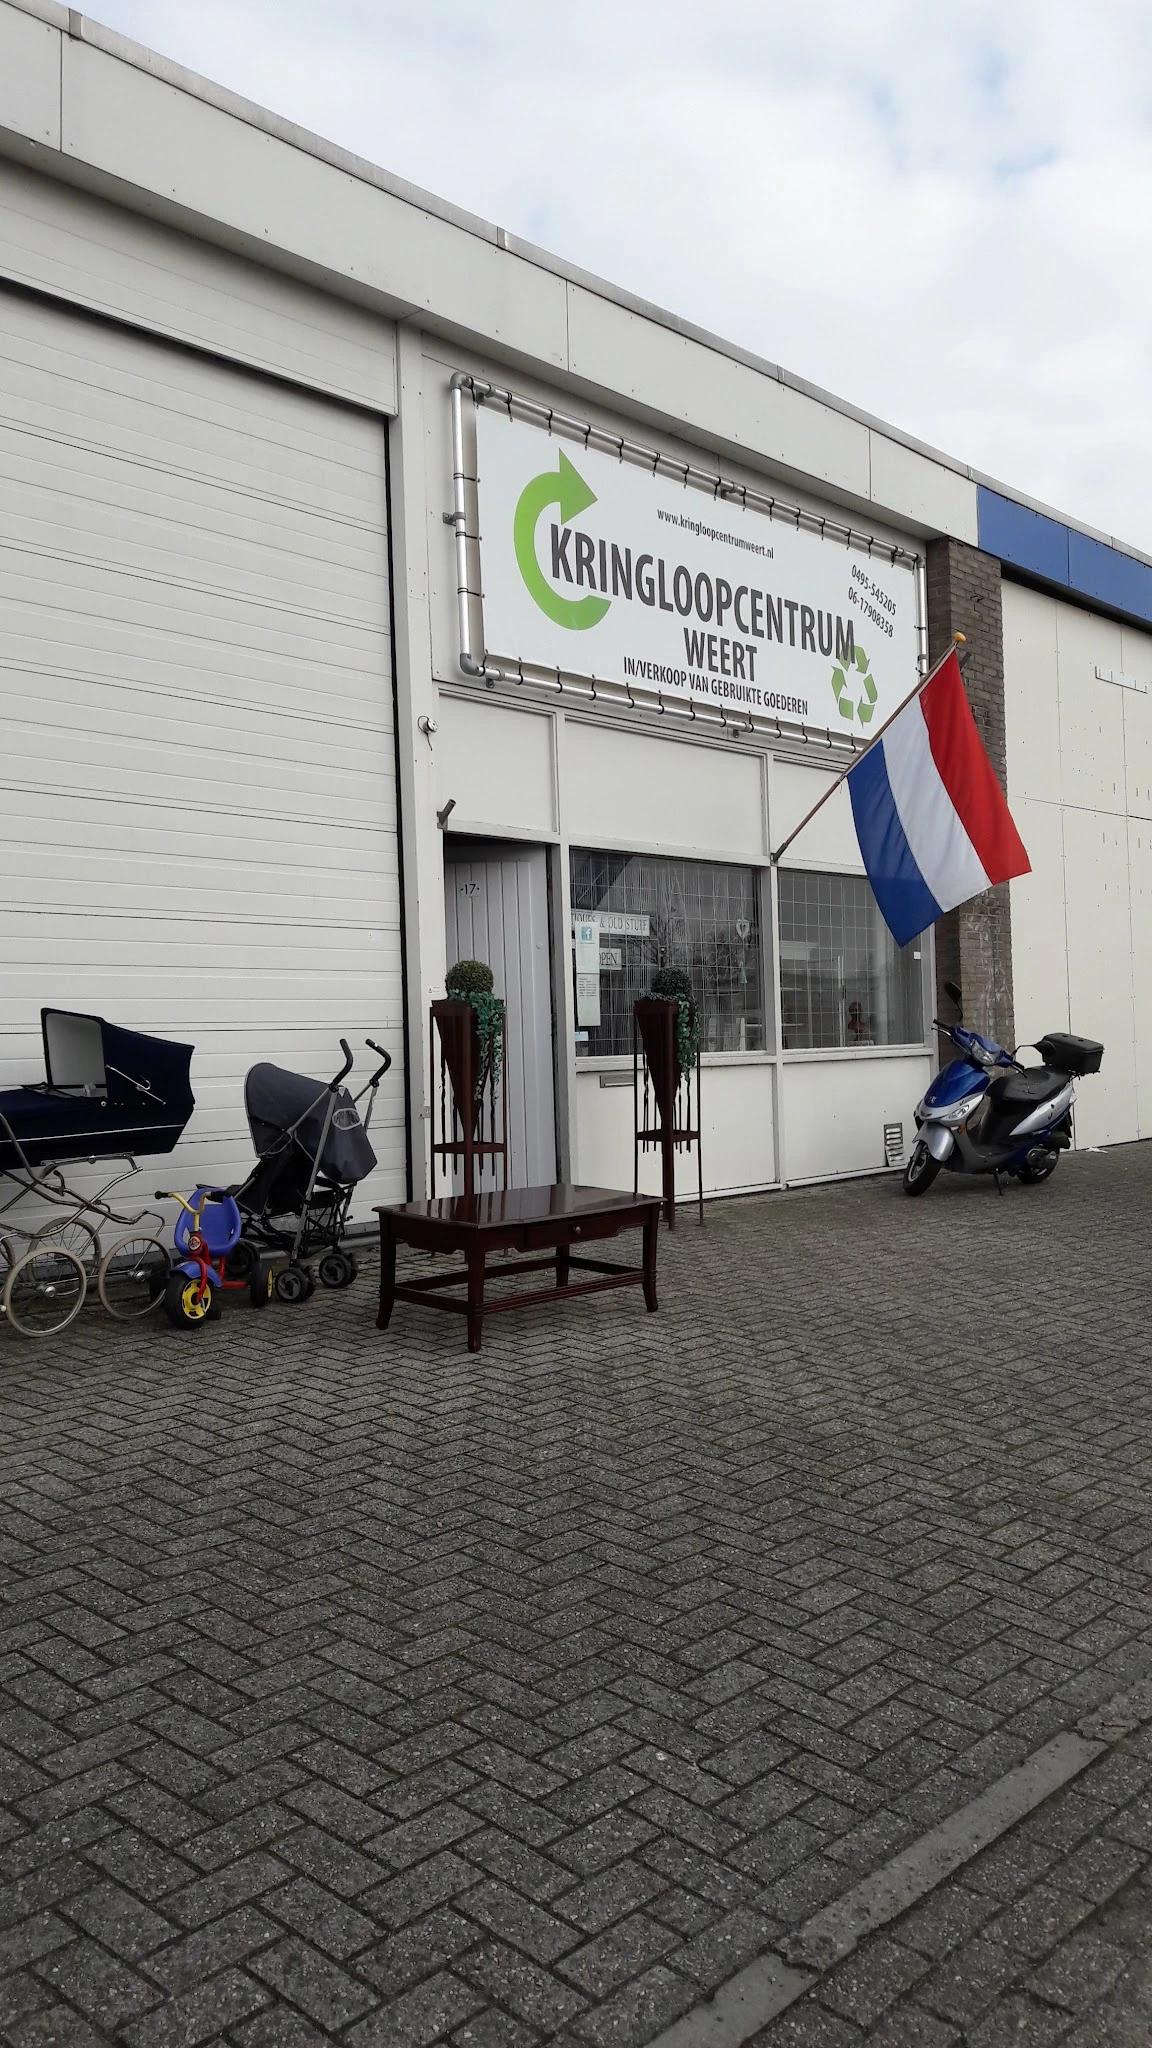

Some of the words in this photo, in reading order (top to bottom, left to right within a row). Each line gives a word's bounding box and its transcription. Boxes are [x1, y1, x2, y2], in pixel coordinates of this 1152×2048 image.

[657, 508, 774, 559] www.kringloopcentrumweert.nl
[550, 523, 856, 664] KRINGLOOPCENTRUM
[848, 586, 894, 638] 06-17908358
[851, 564, 897, 616] 0495-545205
[683, 627, 757, 682] WEERT
[623, 656, 687, 688] IN/VERKOOP
[688, 672, 709, 693] VAN
[711, 678, 762, 706] GEBRUIKTE
[763, 691, 808, 716] GOEDEREN
[608, 916, 623, 929] OLD
[599, 952, 617, 966] PEN
